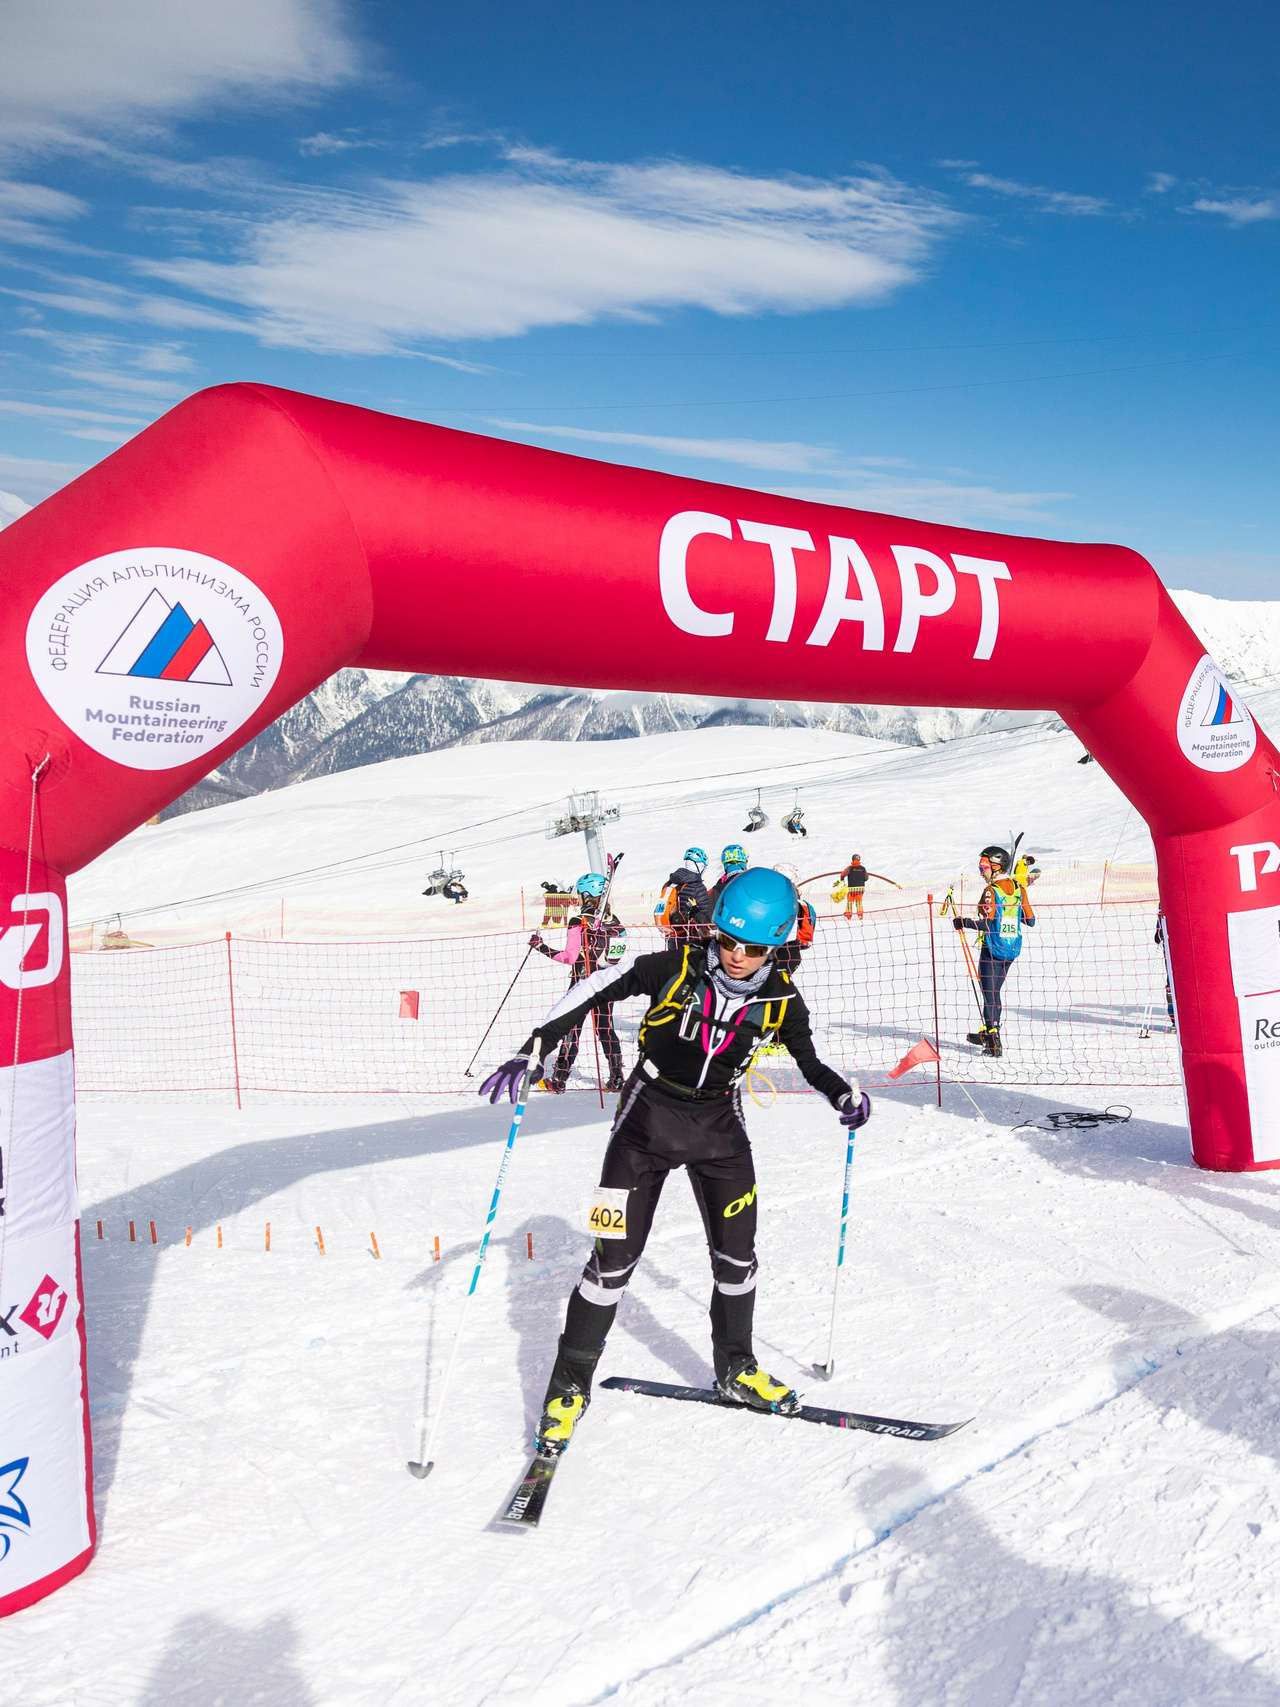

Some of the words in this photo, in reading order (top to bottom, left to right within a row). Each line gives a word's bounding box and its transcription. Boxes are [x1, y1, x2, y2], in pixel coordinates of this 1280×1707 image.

[658, 510, 1013, 660] СТАРТ
[48, 576, 109, 671] ФЕДЕРАЦИЯ
[112, 564, 251, 616] АЛЬПИНИЗМА
[247, 616, 269, 688] РОССИИ
[129, 695, 201, 714] Russian
[85, 708, 228, 732] Mountaineering
[111, 728, 204, 745] Federation
[1210, 733, 1238, 742] Russian
[1191, 740, 1251, 751] Mountaineering
[1201, 749, 1243, 759] Federation
[1002, 924, 1016, 933] 215
[609, 944, 626, 954] 209
[590, 1207, 624, 1228] 402
[875, 1424, 926, 1438] TRAB
[507, 1496, 531, 1520] TRAB
